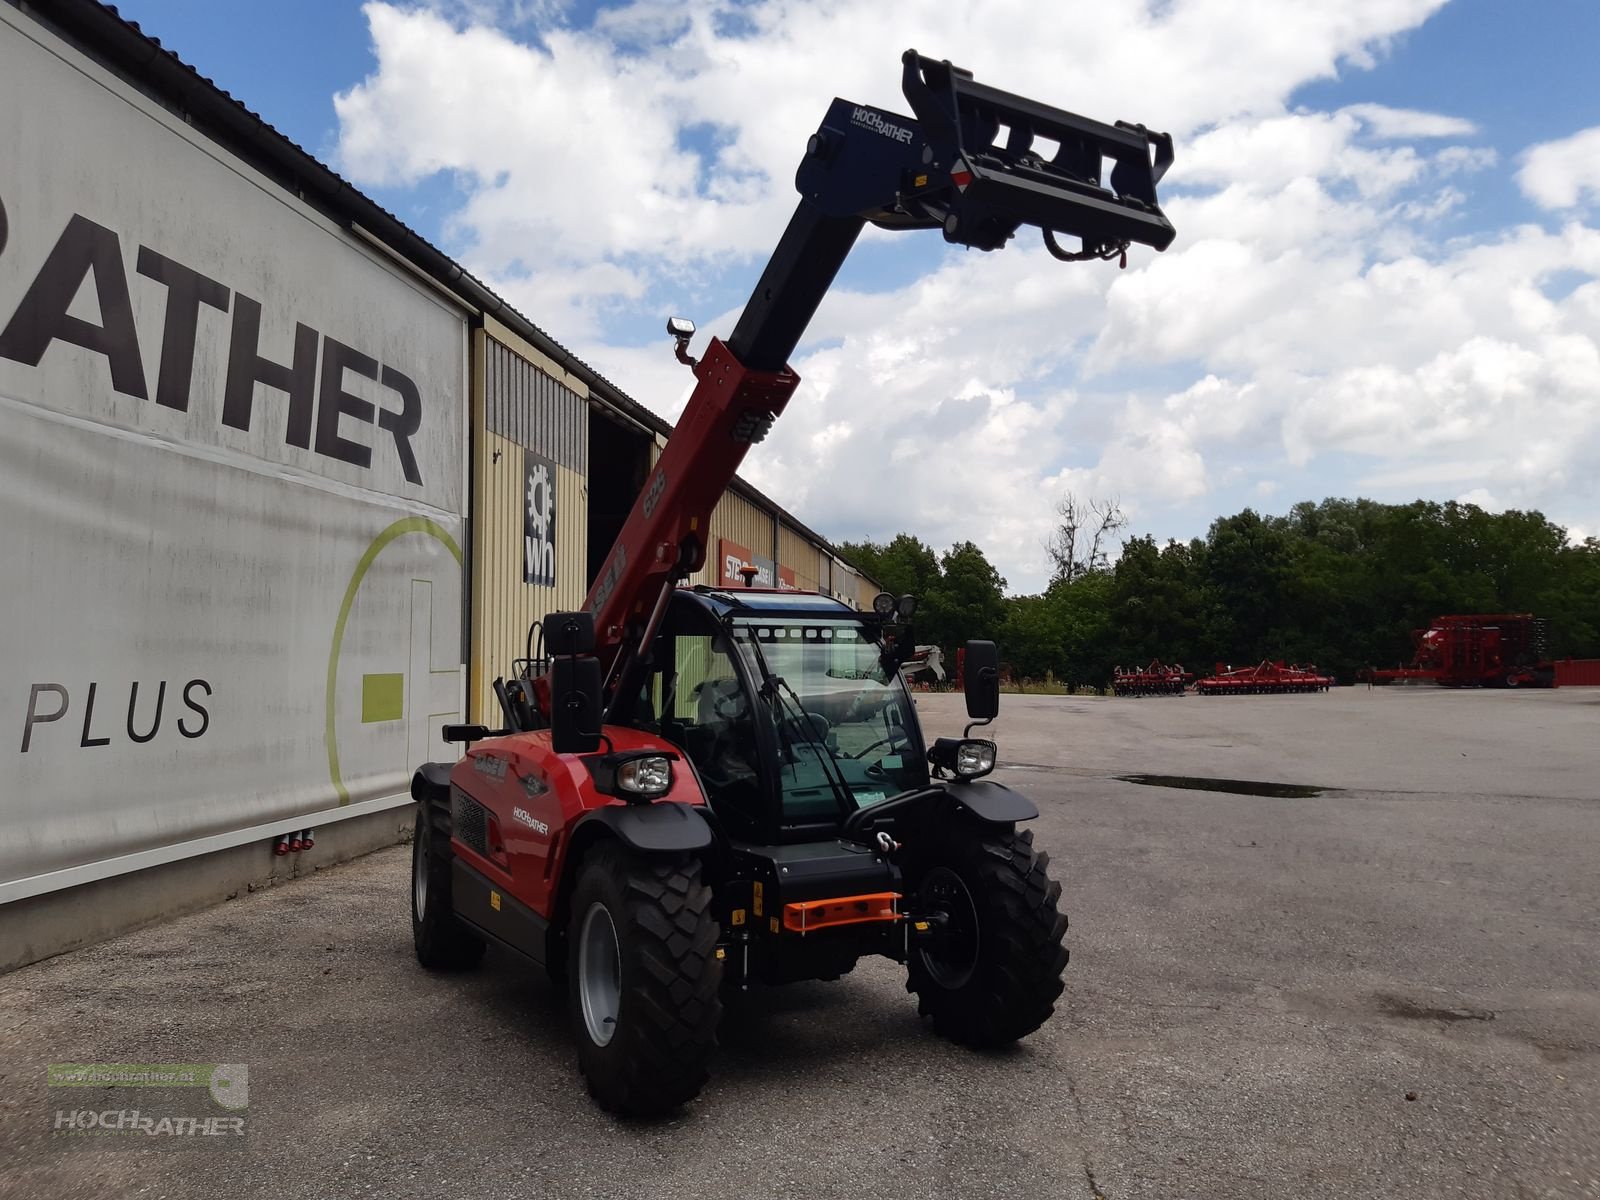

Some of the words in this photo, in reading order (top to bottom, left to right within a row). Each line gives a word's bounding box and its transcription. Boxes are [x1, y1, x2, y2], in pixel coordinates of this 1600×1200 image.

[852, 107, 913, 144] HOCHRATHER
[0, 197, 424, 486] ATHER
[21, 679, 212, 753] PLUS
[513, 806, 548, 836] HOCHRATHER
